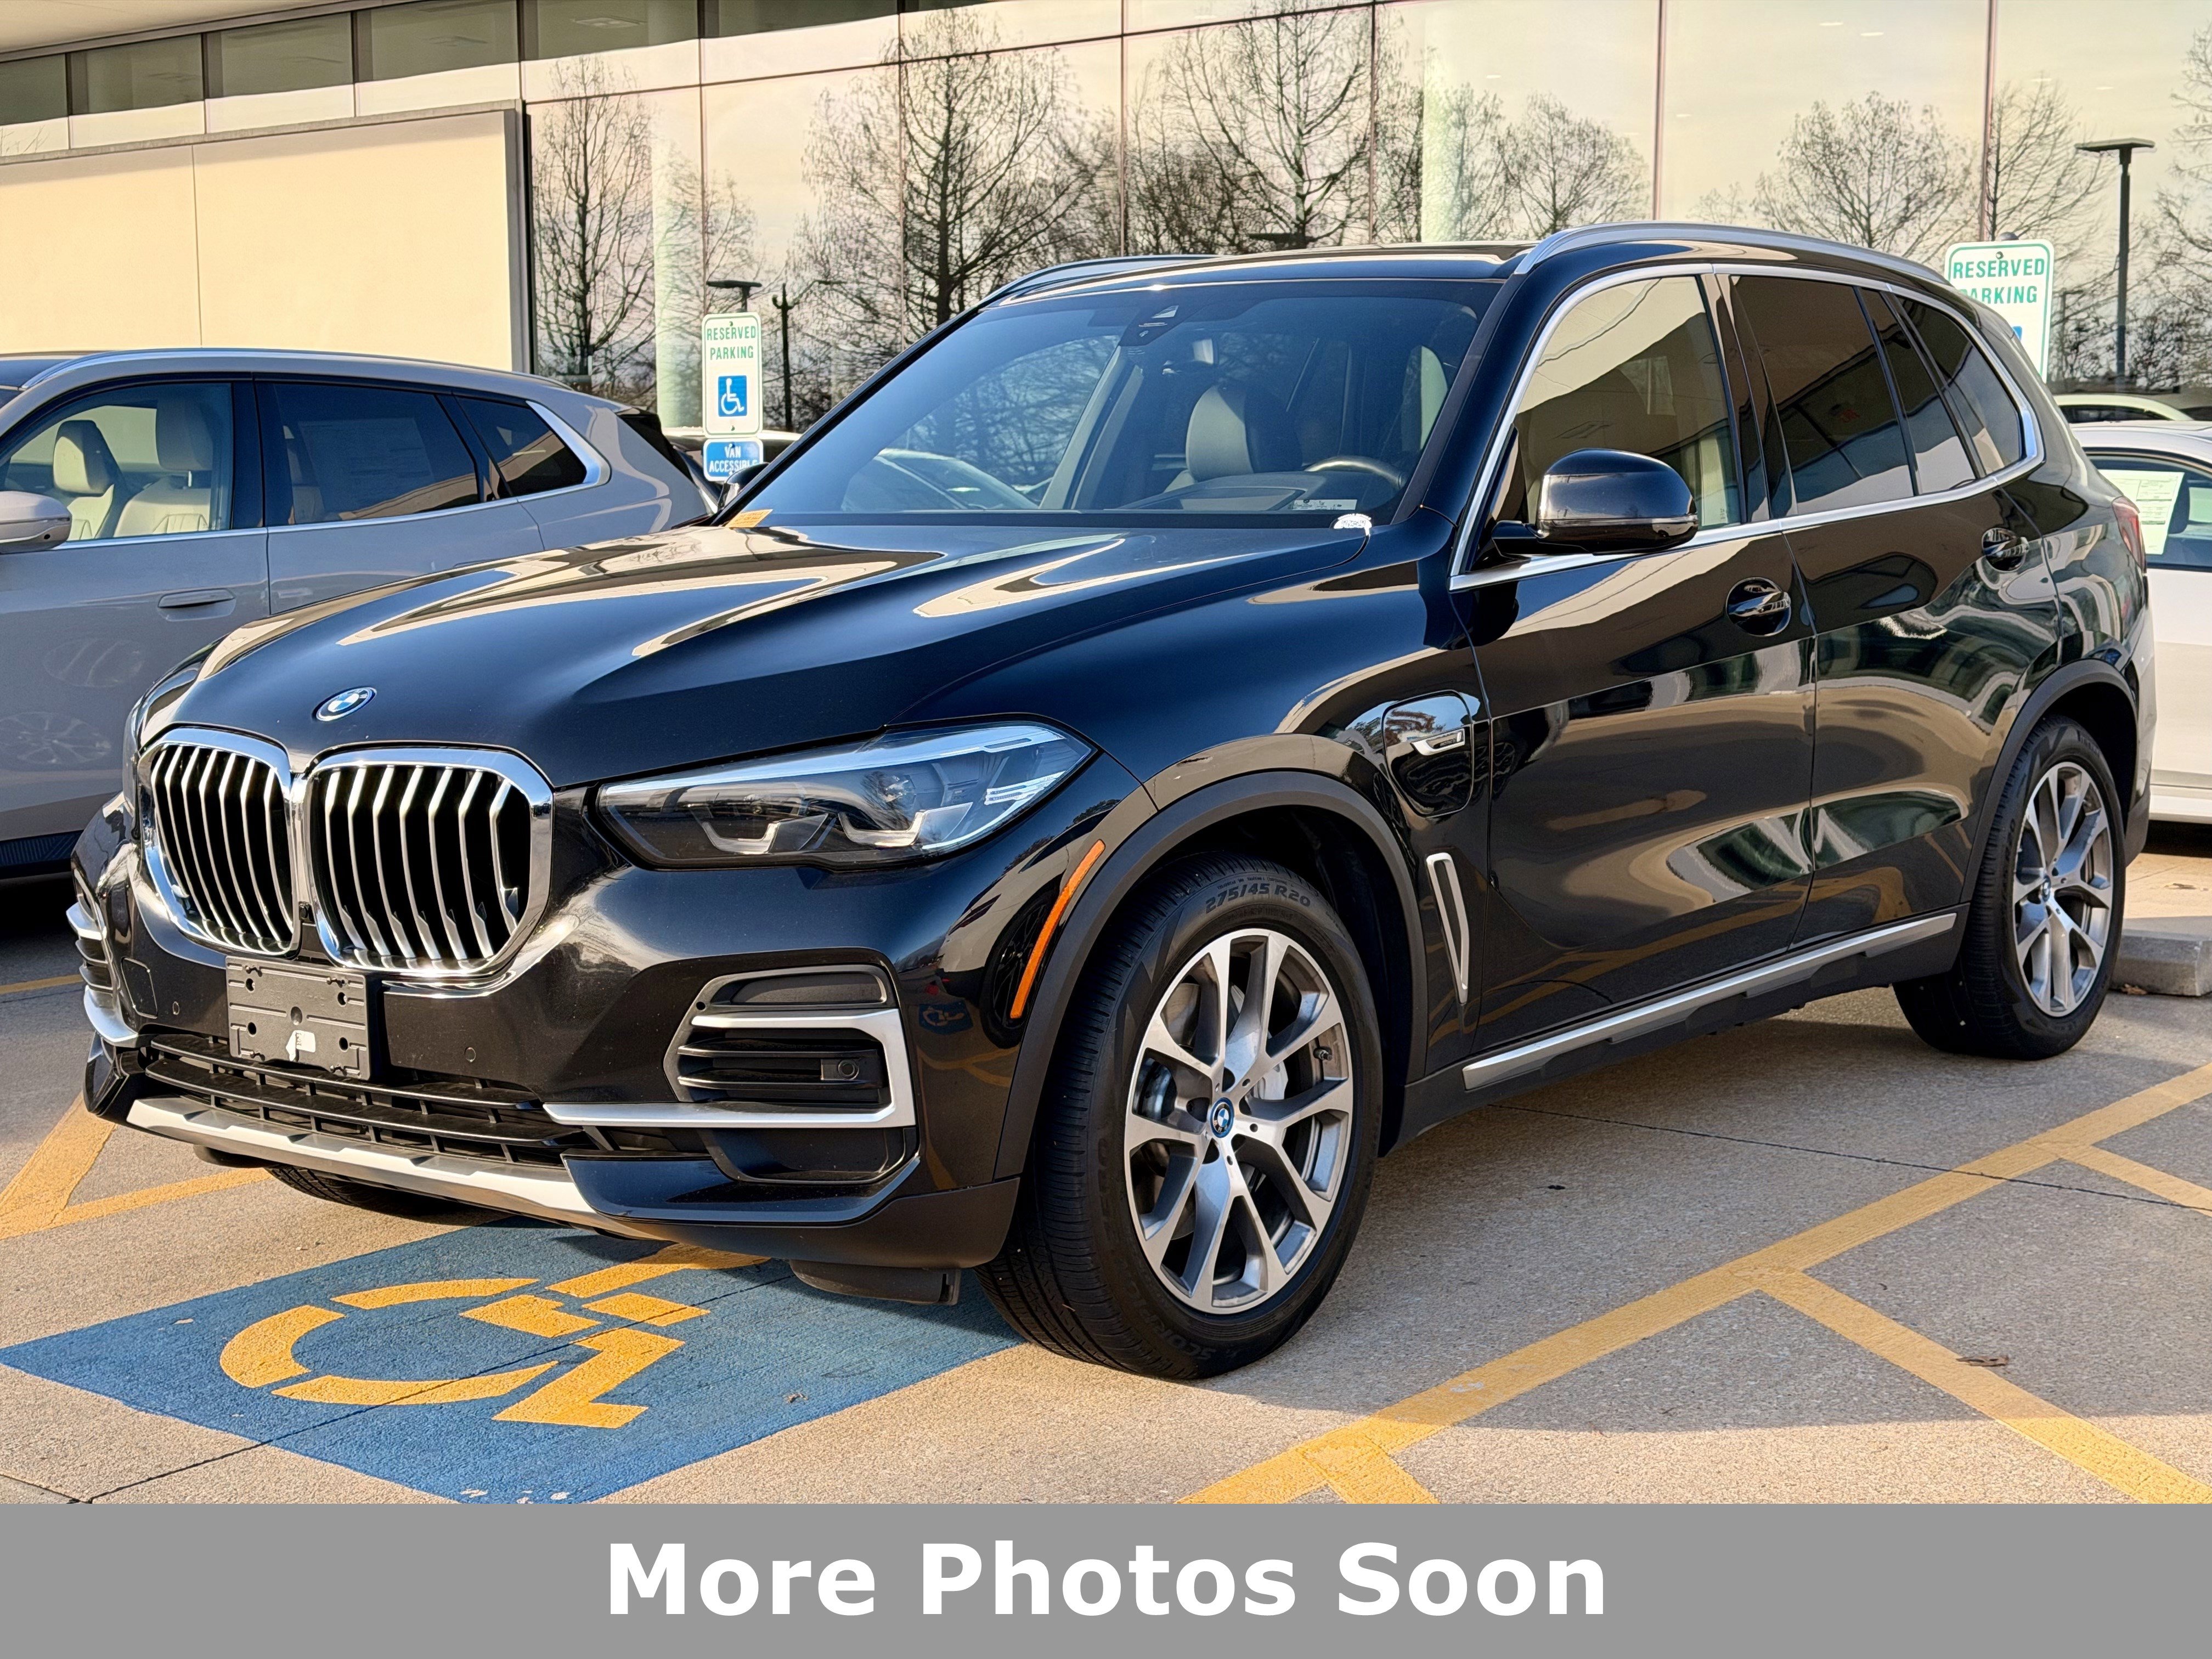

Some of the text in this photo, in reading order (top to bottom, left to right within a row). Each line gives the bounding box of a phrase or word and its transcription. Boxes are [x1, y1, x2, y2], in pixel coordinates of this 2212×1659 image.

[1953, 258, 2045, 279] RESERVED
[707, 325, 756, 341] RESERVED
[710, 345, 754, 360] PARKING
[725, 446, 741, 458] VAN
[1205, 883, 1270, 914] 275/45
[1274, 884, 1311, 907] R20
